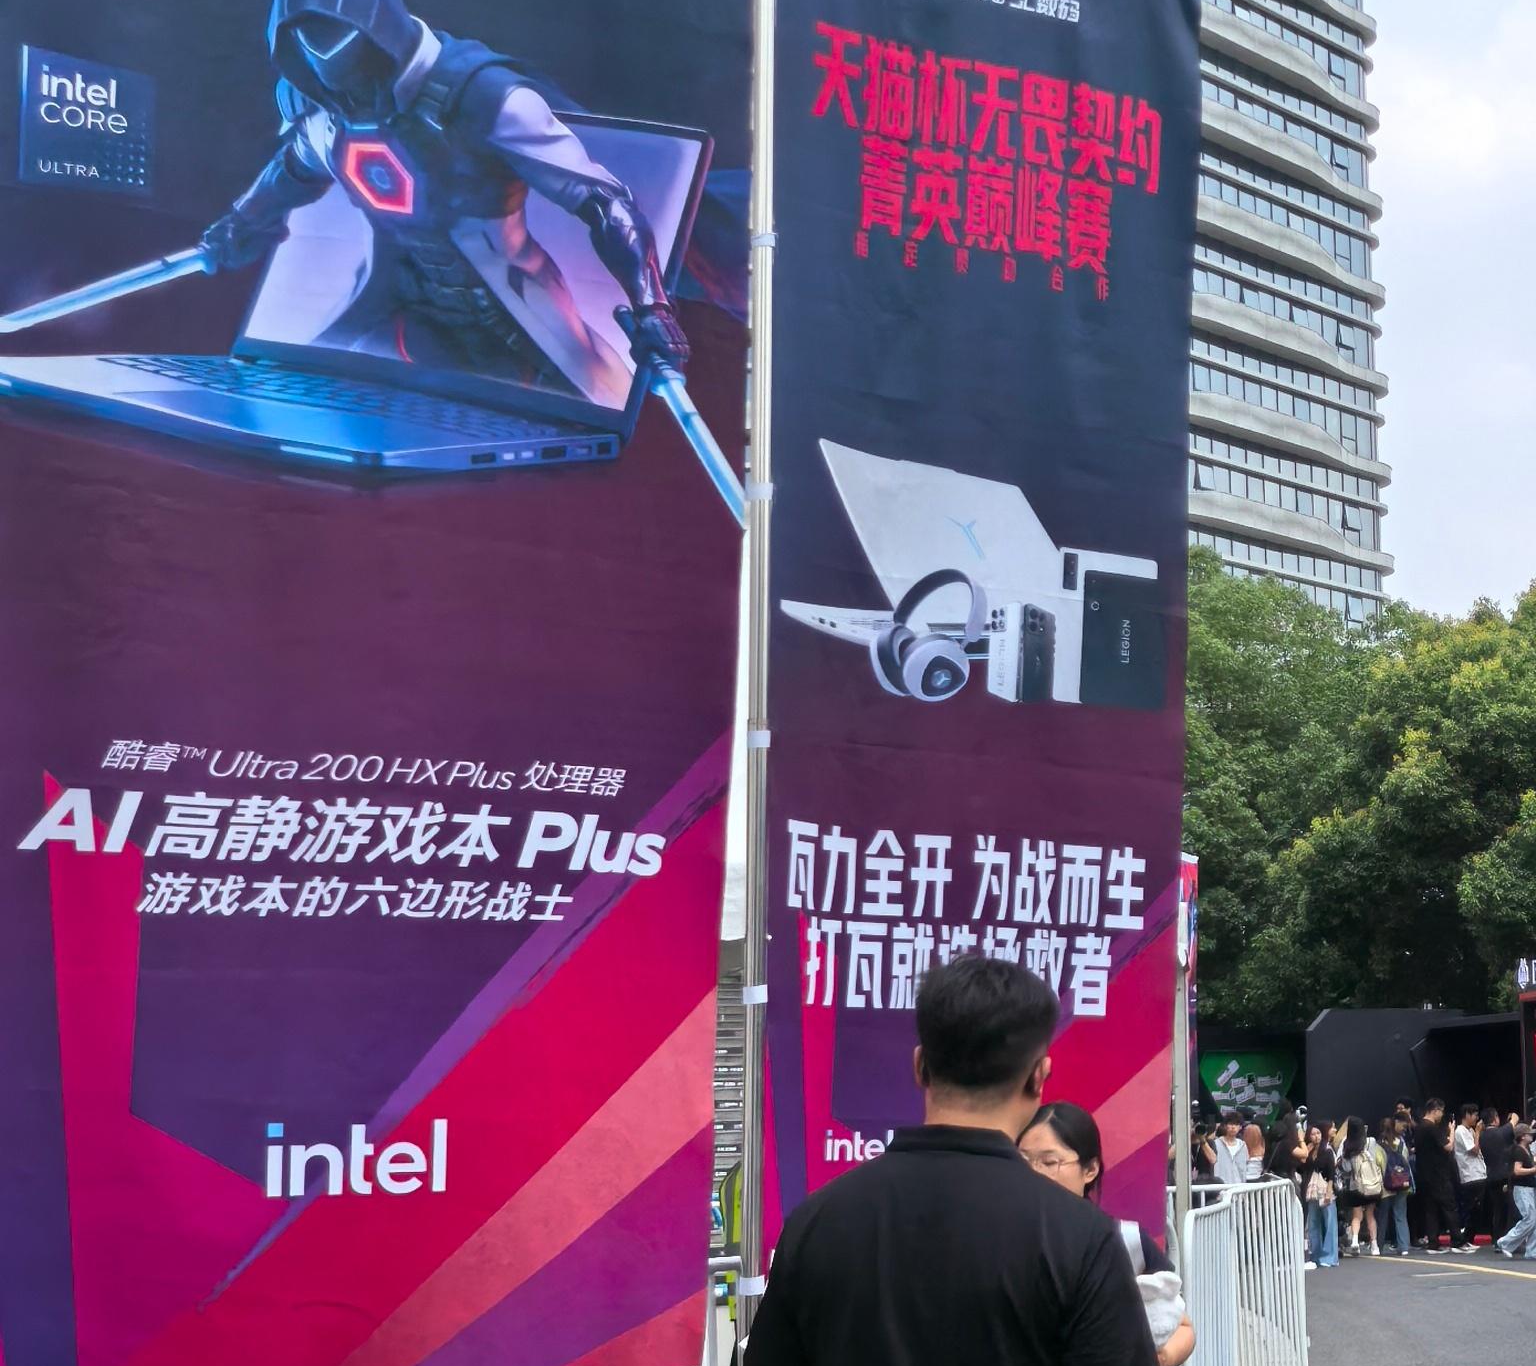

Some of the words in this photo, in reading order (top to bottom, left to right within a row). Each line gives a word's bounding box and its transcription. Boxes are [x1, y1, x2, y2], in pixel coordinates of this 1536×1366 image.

[40, 64, 118, 109] intel
[810, 20, 1163, 196] 天猫杯无畏契约
[39, 158, 101, 179] ULTRA
[858, 135, 1114, 275] 菁英巅峰赛
[1120, 619, 1132, 664] LEGION
[207, 750, 299, 782] Ultra
[300, 752, 384, 785] 200
[385, 758, 446, 787] HX
[447, 761, 516, 792] Plus
[519, 760, 627, 798] 处理器
[17, 788, 143, 854] AI
[144, 793, 510, 868] 高静游戏本
[516, 810, 667, 878] Plus
[136, 872, 574, 923] 游戏本的六边形战士
[787, 819, 954, 919] 瓦力全开
[972, 834, 1147, 930] 为战而生
[265, 1118, 449, 1198] intel
[825, 1129, 894, 1164] inte
